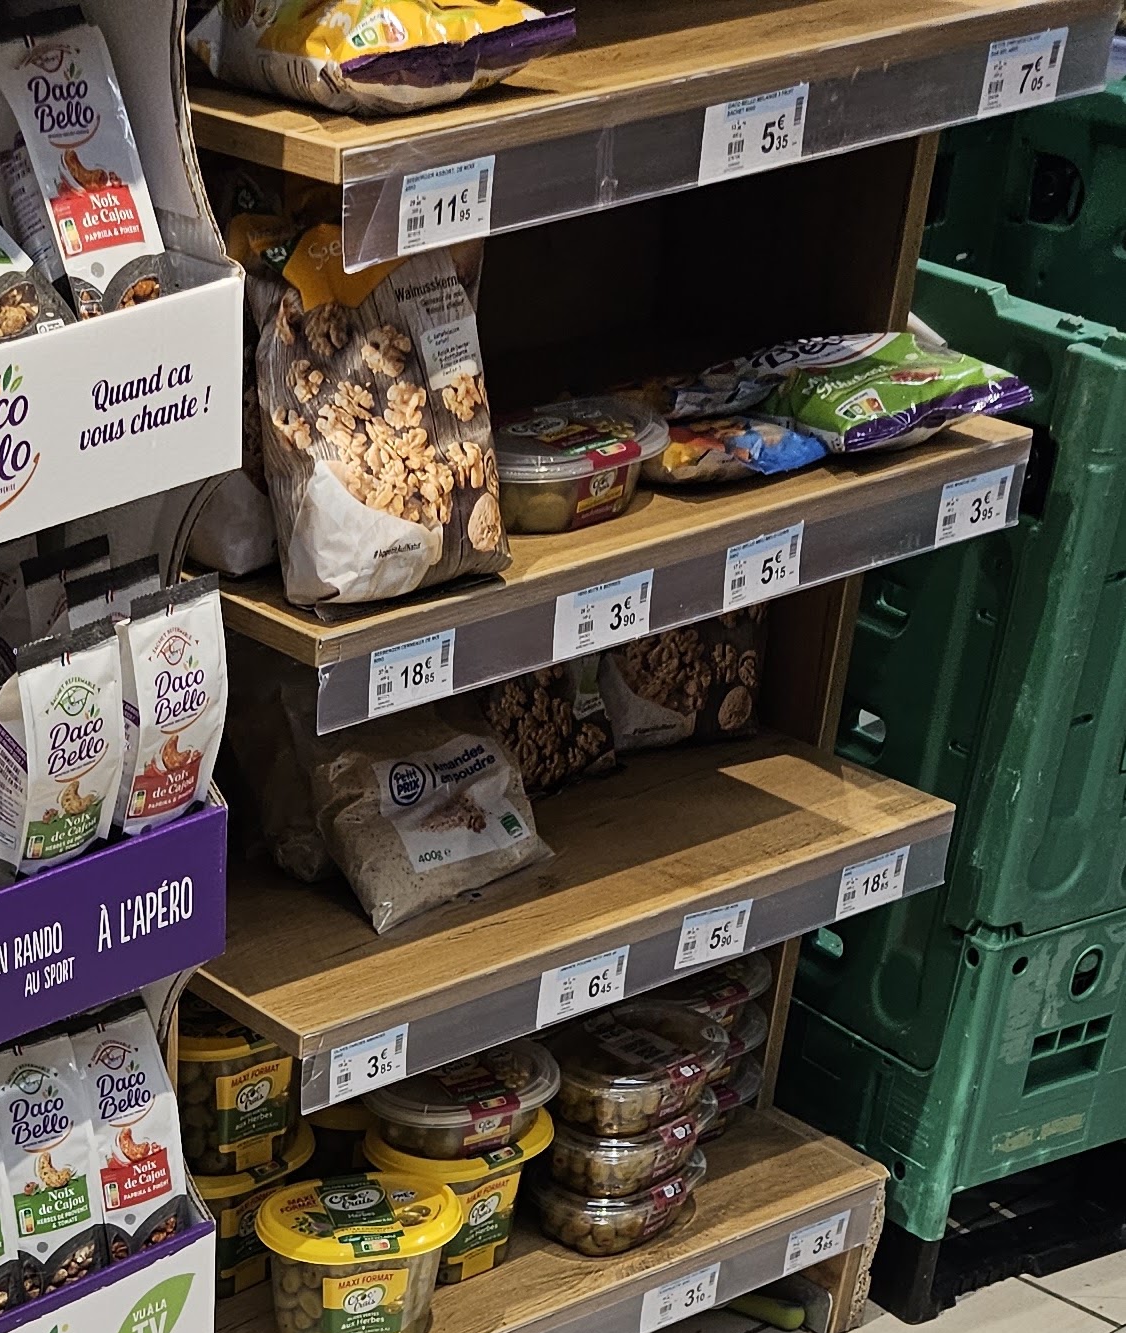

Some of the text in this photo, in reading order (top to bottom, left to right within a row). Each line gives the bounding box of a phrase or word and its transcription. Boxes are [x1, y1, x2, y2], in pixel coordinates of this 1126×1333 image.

[90, 193, 119, 209] Noix
[82, 208, 134, 228] de Cajou
[395, 275, 460, 302] Walnusskern
[92, 363, 192, 413] Quand ca
[79, 385, 211, 451] vous chante !
[155, 669, 205, 699] Daco
[154, 689, 206, 725] Bello
[49, 717, 104, 751] Daco
[48, 737, 104, 776] Bello
[432, 744, 485, 772] Amandes
[440, 754, 496, 784] en poudre
[394, 768, 417, 782] Petit
[396, 778, 419, 795] PRIX
[418, 850, 443, 862] 400g
[97, 876, 194, 952] À L'APÉRO
[14, 922, 63, 969] RANDO
[25, 956, 76, 998] AU SPORT
[124, 1169, 166, 1190] de Cajou
[132, 1160, 157, 1175] Noix
[38, 1194, 85, 1216] de Cajou
[47, 1186, 75, 1201] Noix
[132, 1298, 167, 1323] VU À LA
